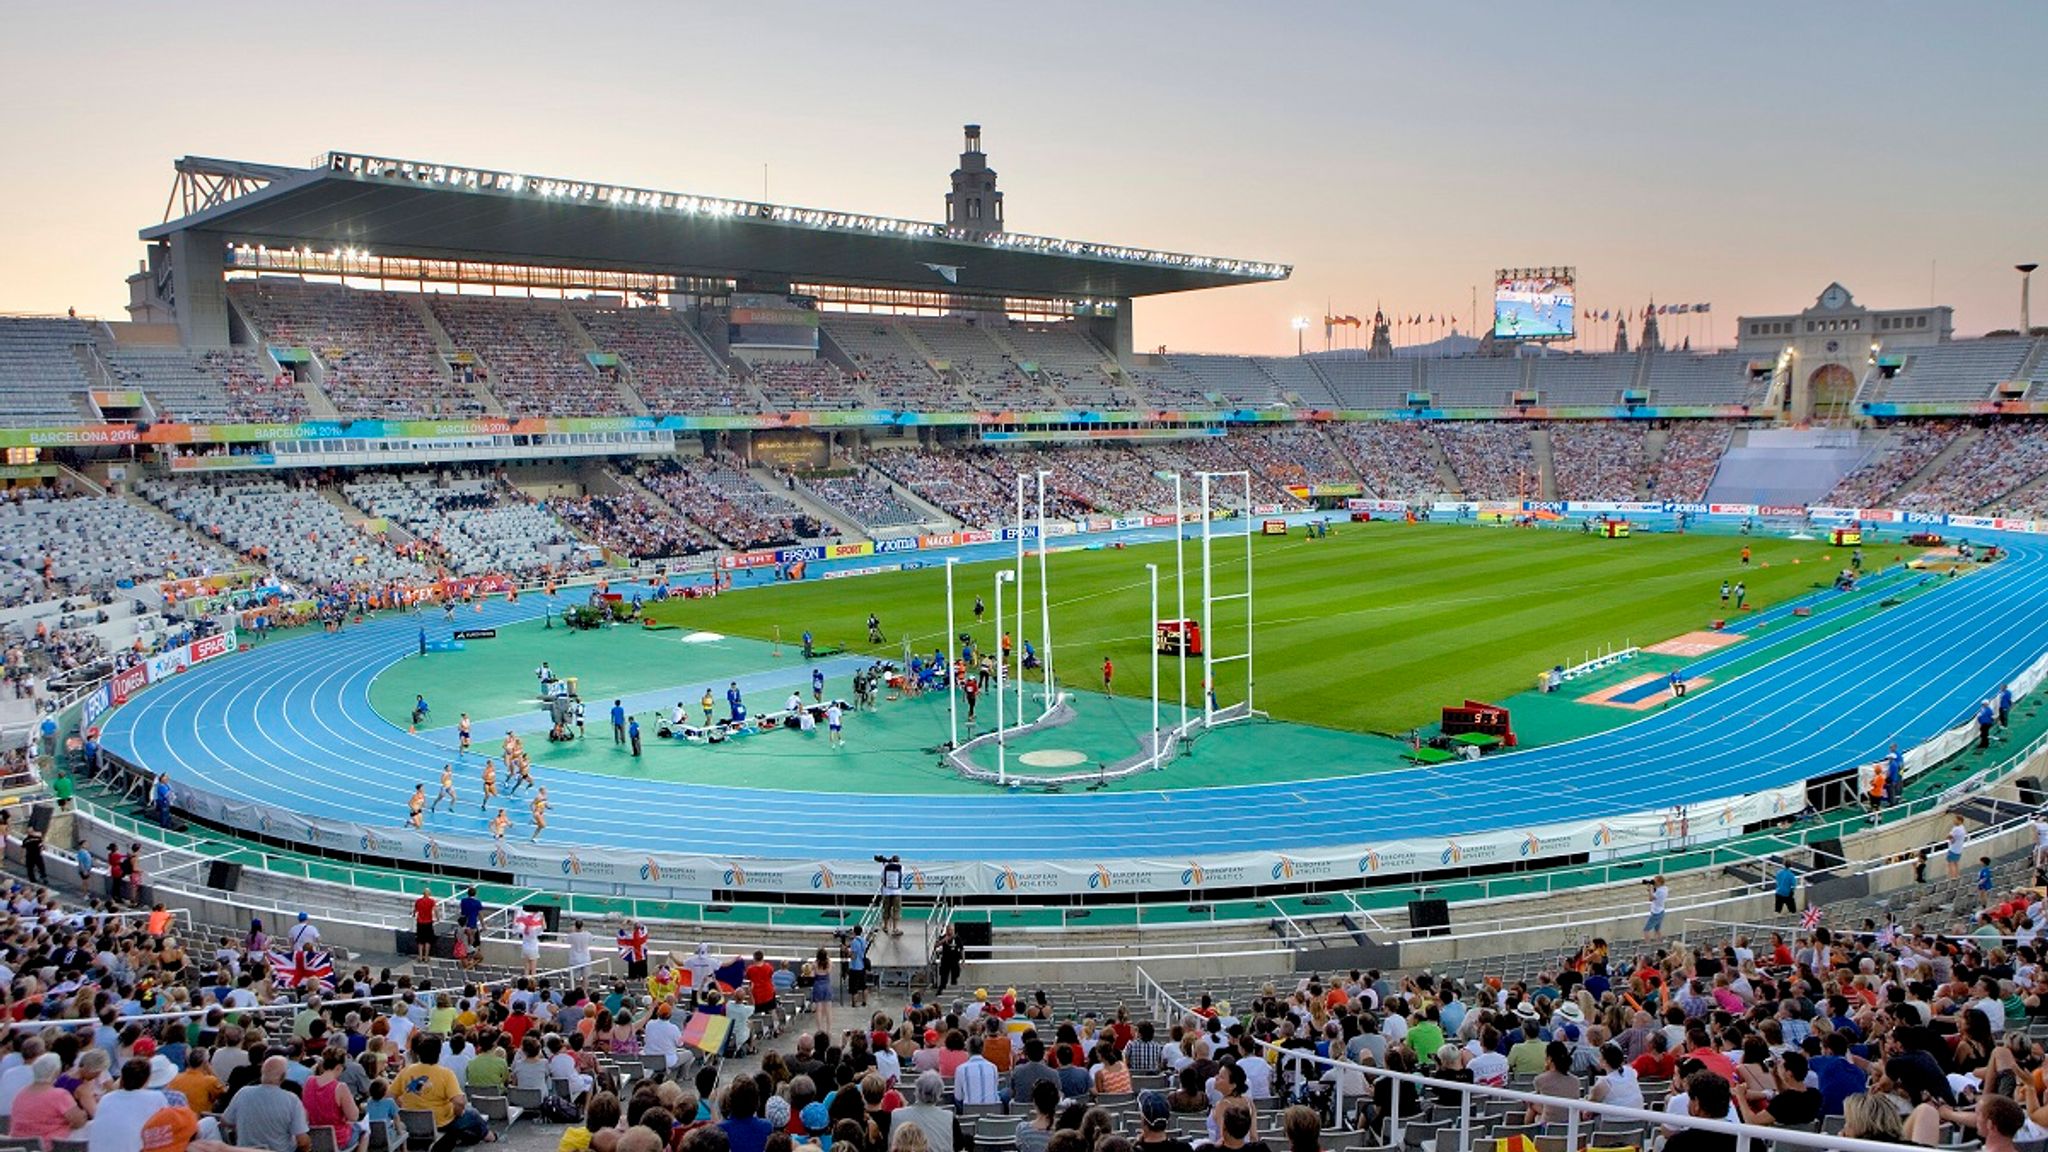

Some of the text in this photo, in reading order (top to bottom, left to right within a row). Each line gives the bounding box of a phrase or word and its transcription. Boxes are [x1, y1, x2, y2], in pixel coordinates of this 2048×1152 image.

[30, 430, 139, 443] BARCELONA 2010
[254, 427, 317, 438] BARCELONA
[1909, 513, 1942, 524] EPSON
[1007, 527, 1036, 539] EPON
[783, 548, 819, 561] EPSON
[198, 639, 225, 657] SPAR
[122, 671, 147, 695] OMEGA
[660, 867, 696, 875] EUROPEAN
